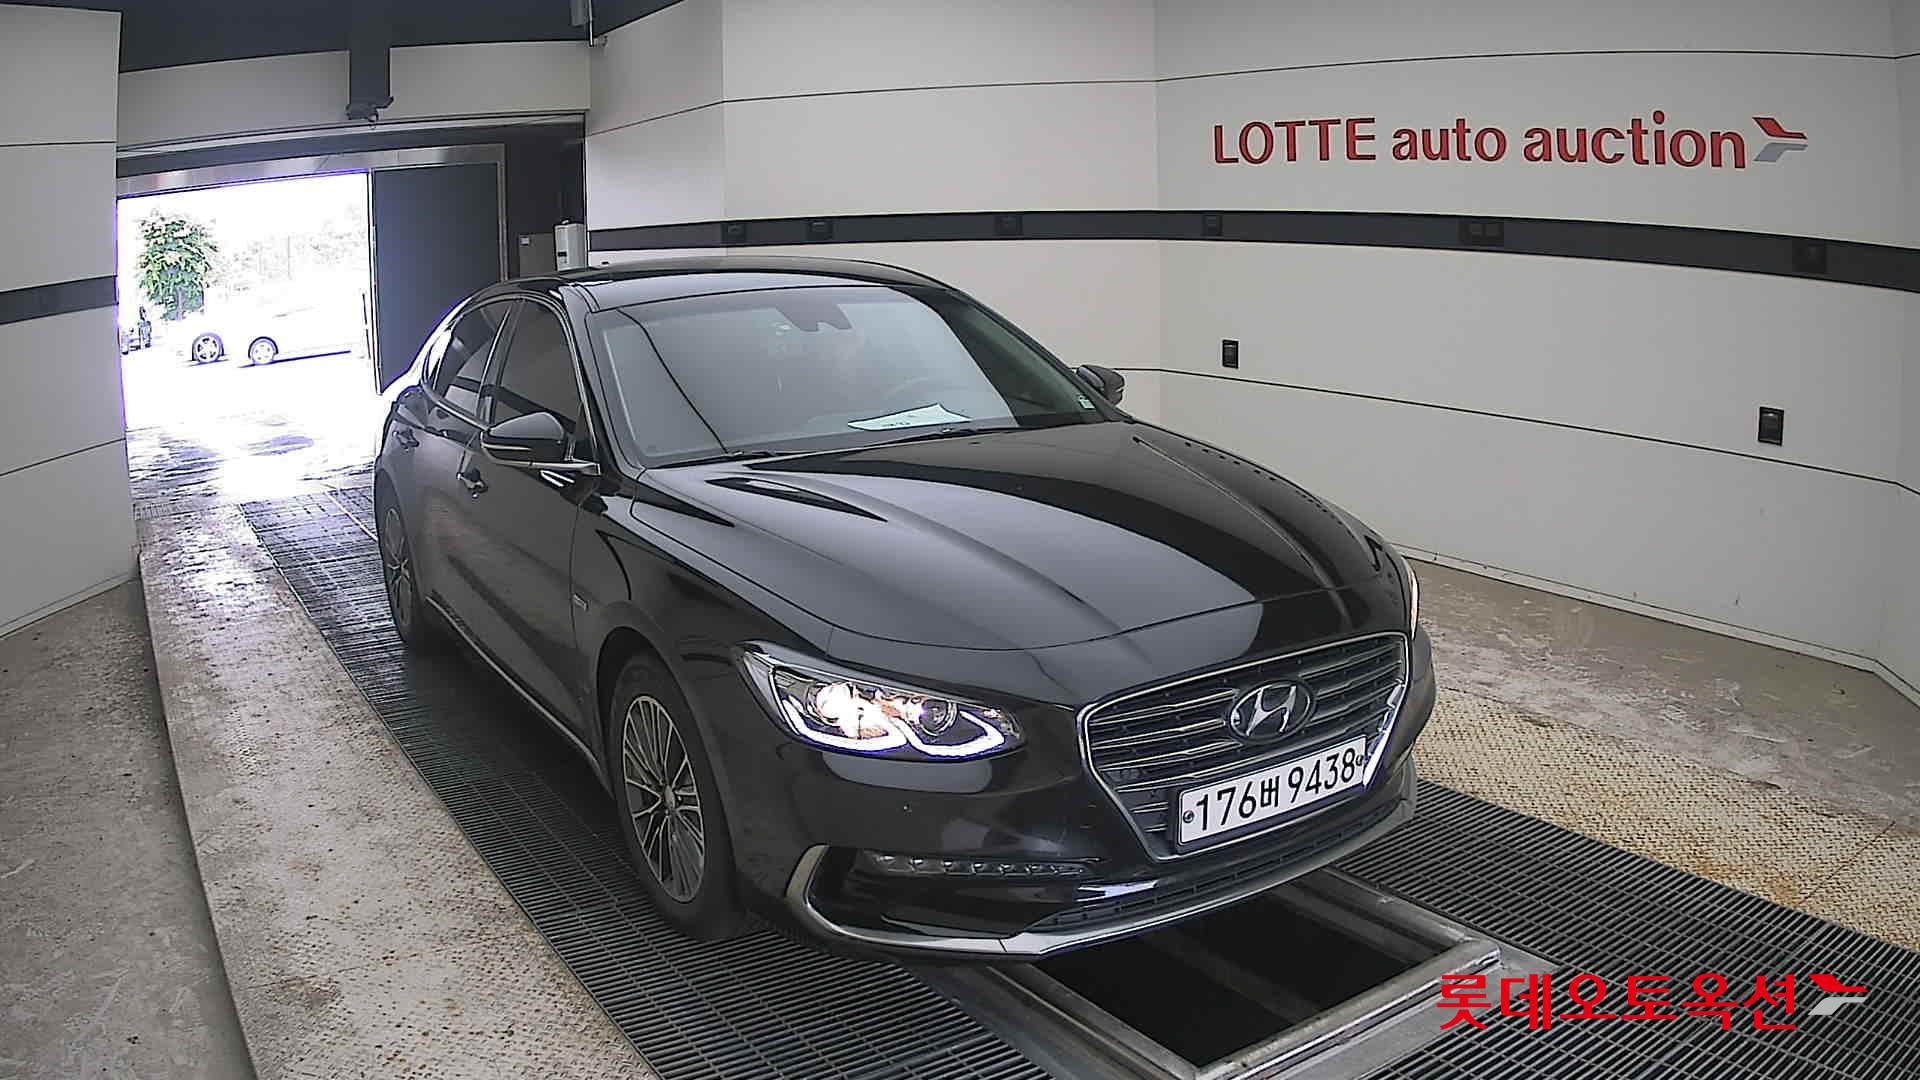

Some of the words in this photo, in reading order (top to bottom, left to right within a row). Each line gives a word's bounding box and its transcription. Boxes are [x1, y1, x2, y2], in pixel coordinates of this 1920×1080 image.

[1213, 117, 1376, 164] LOTTE
[1391, 118, 1507, 162] auto
[1522, 110, 1746, 169] auction
[1288, 748, 1356, 803] 9438
